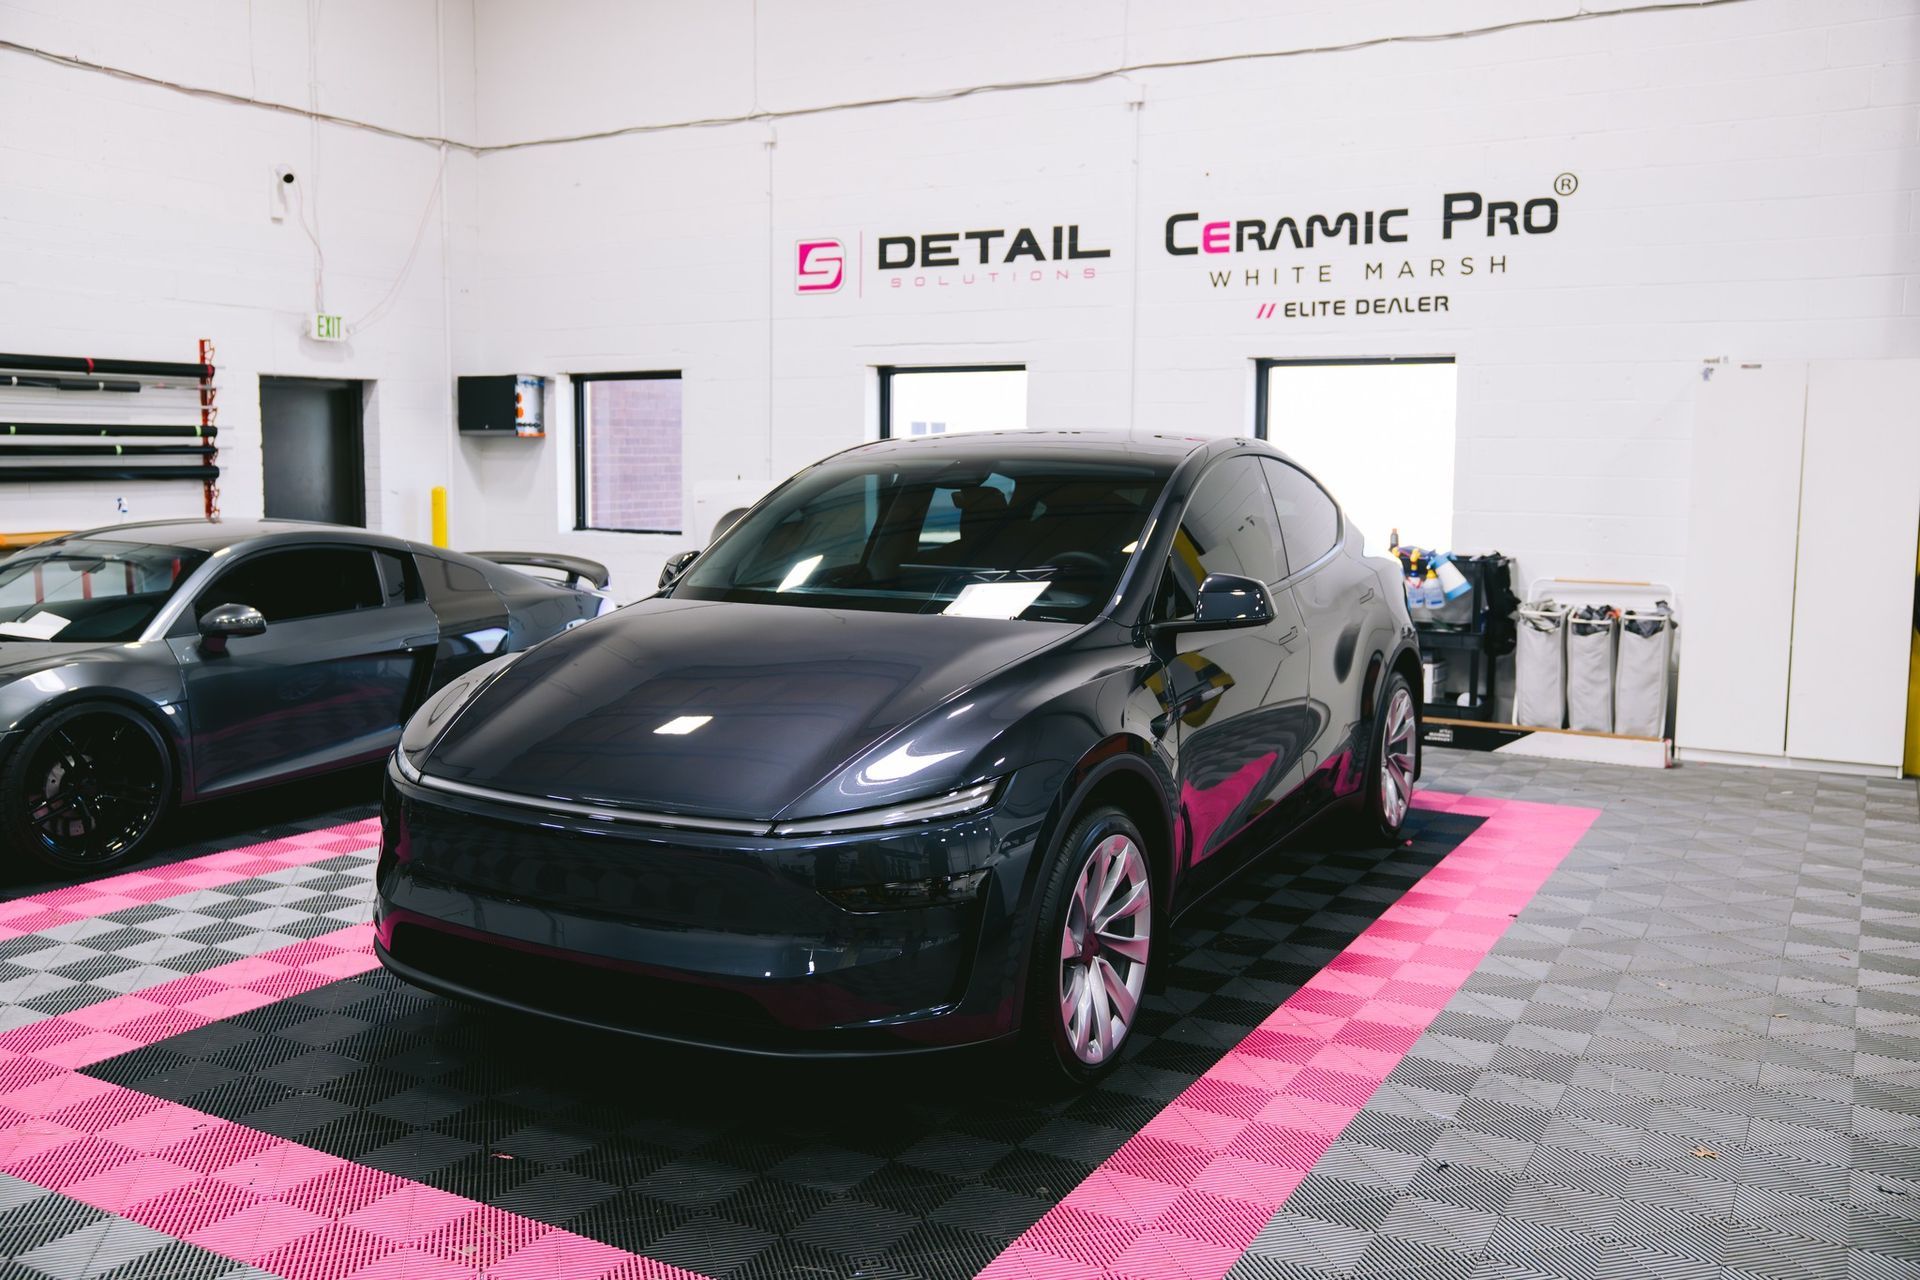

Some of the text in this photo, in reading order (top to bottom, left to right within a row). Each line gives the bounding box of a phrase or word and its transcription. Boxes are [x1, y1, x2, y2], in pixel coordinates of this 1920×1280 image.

[878, 224, 1111, 270] DETAIL
[1165, 209, 1409, 256] CERAMIC
[890, 267, 1096, 289] SOLUTIONS
[1209, 255, 1507, 289] WHITE MARSH
[1284, 300, 1346, 319] ELITE
[1355, 295, 1449, 316] DEALER
[317, 314, 342, 338] EXIT
